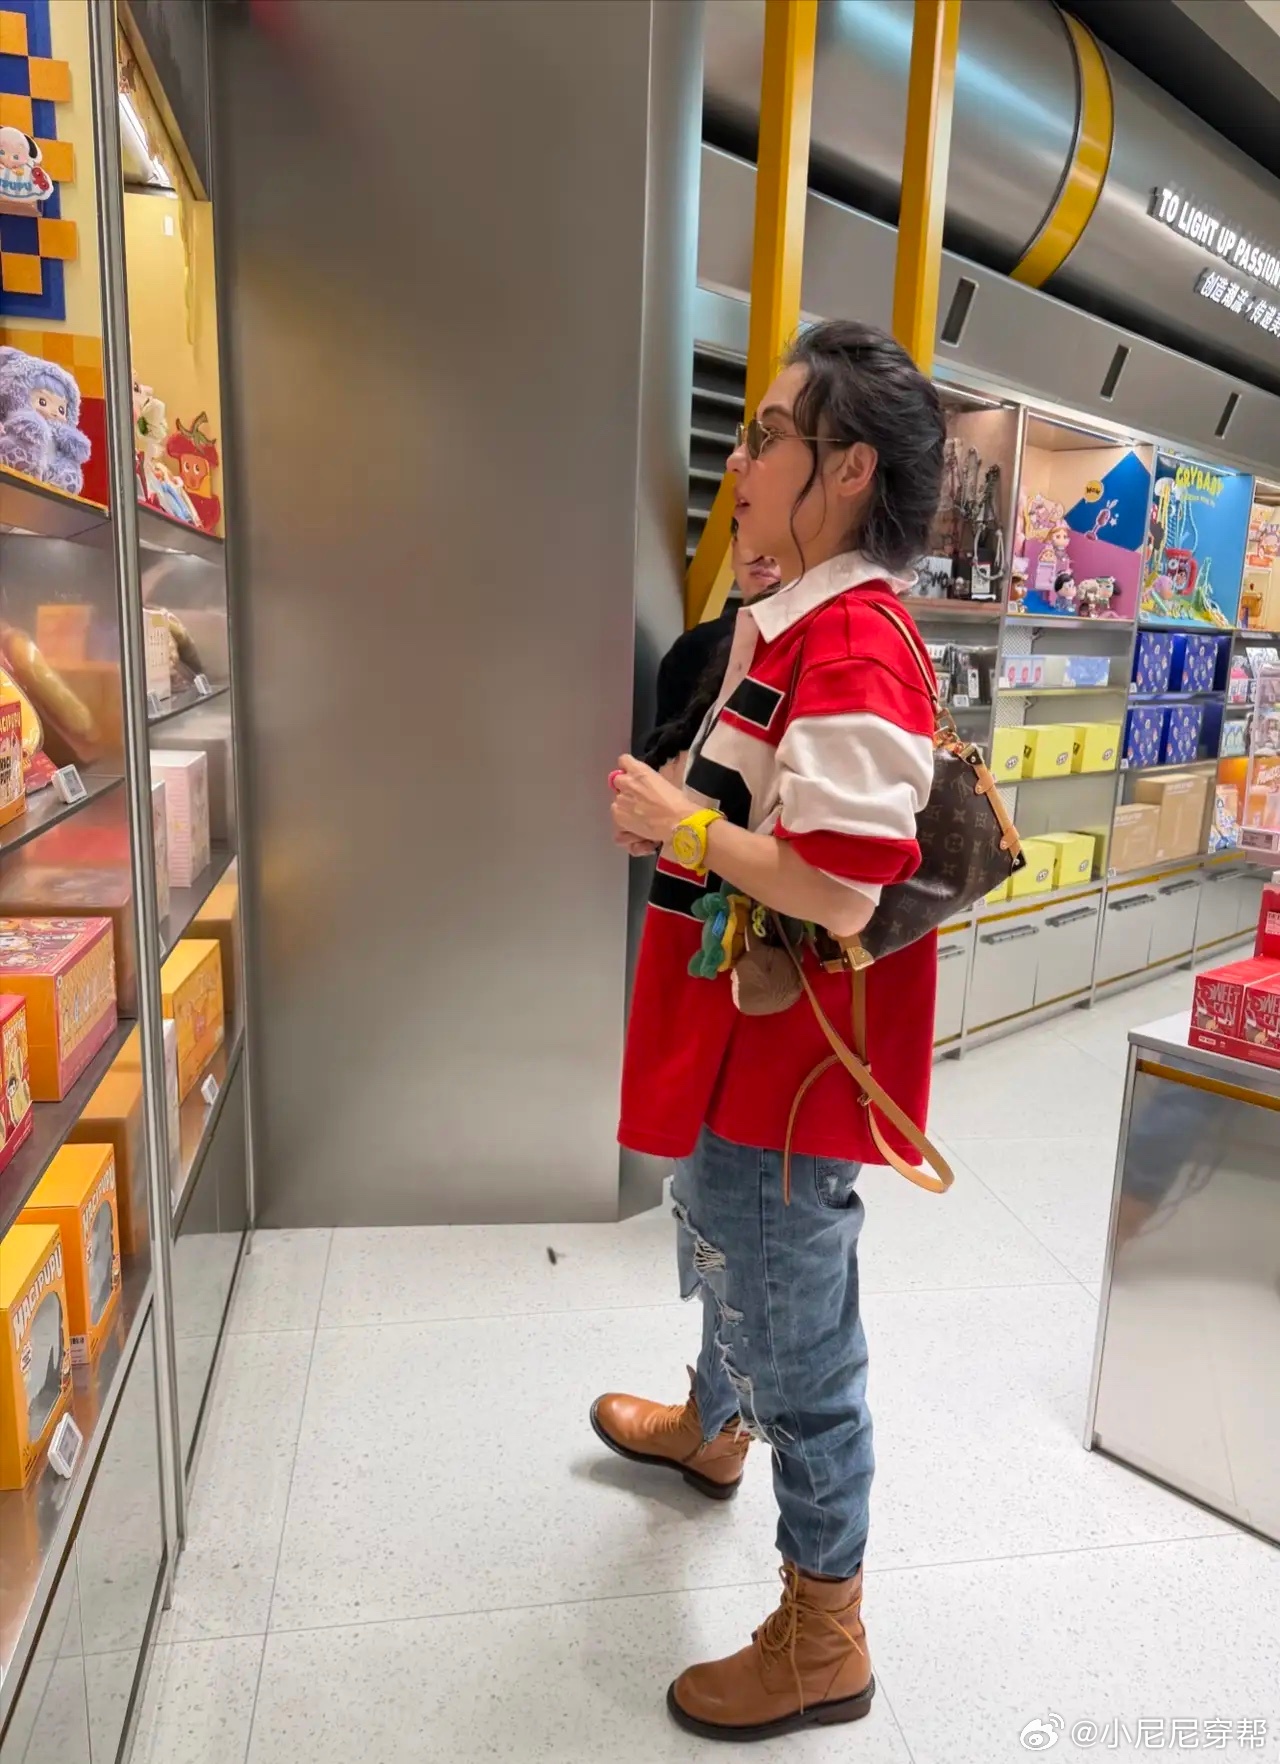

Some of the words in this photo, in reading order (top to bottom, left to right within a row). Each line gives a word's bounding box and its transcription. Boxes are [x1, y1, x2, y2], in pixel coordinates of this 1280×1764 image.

[1159, 188, 1180, 222] TO
[1178, 201, 1219, 246] LIGHT
[1217, 226, 1237, 256] UP
[1234, 237, 1280, 286] PASSION
